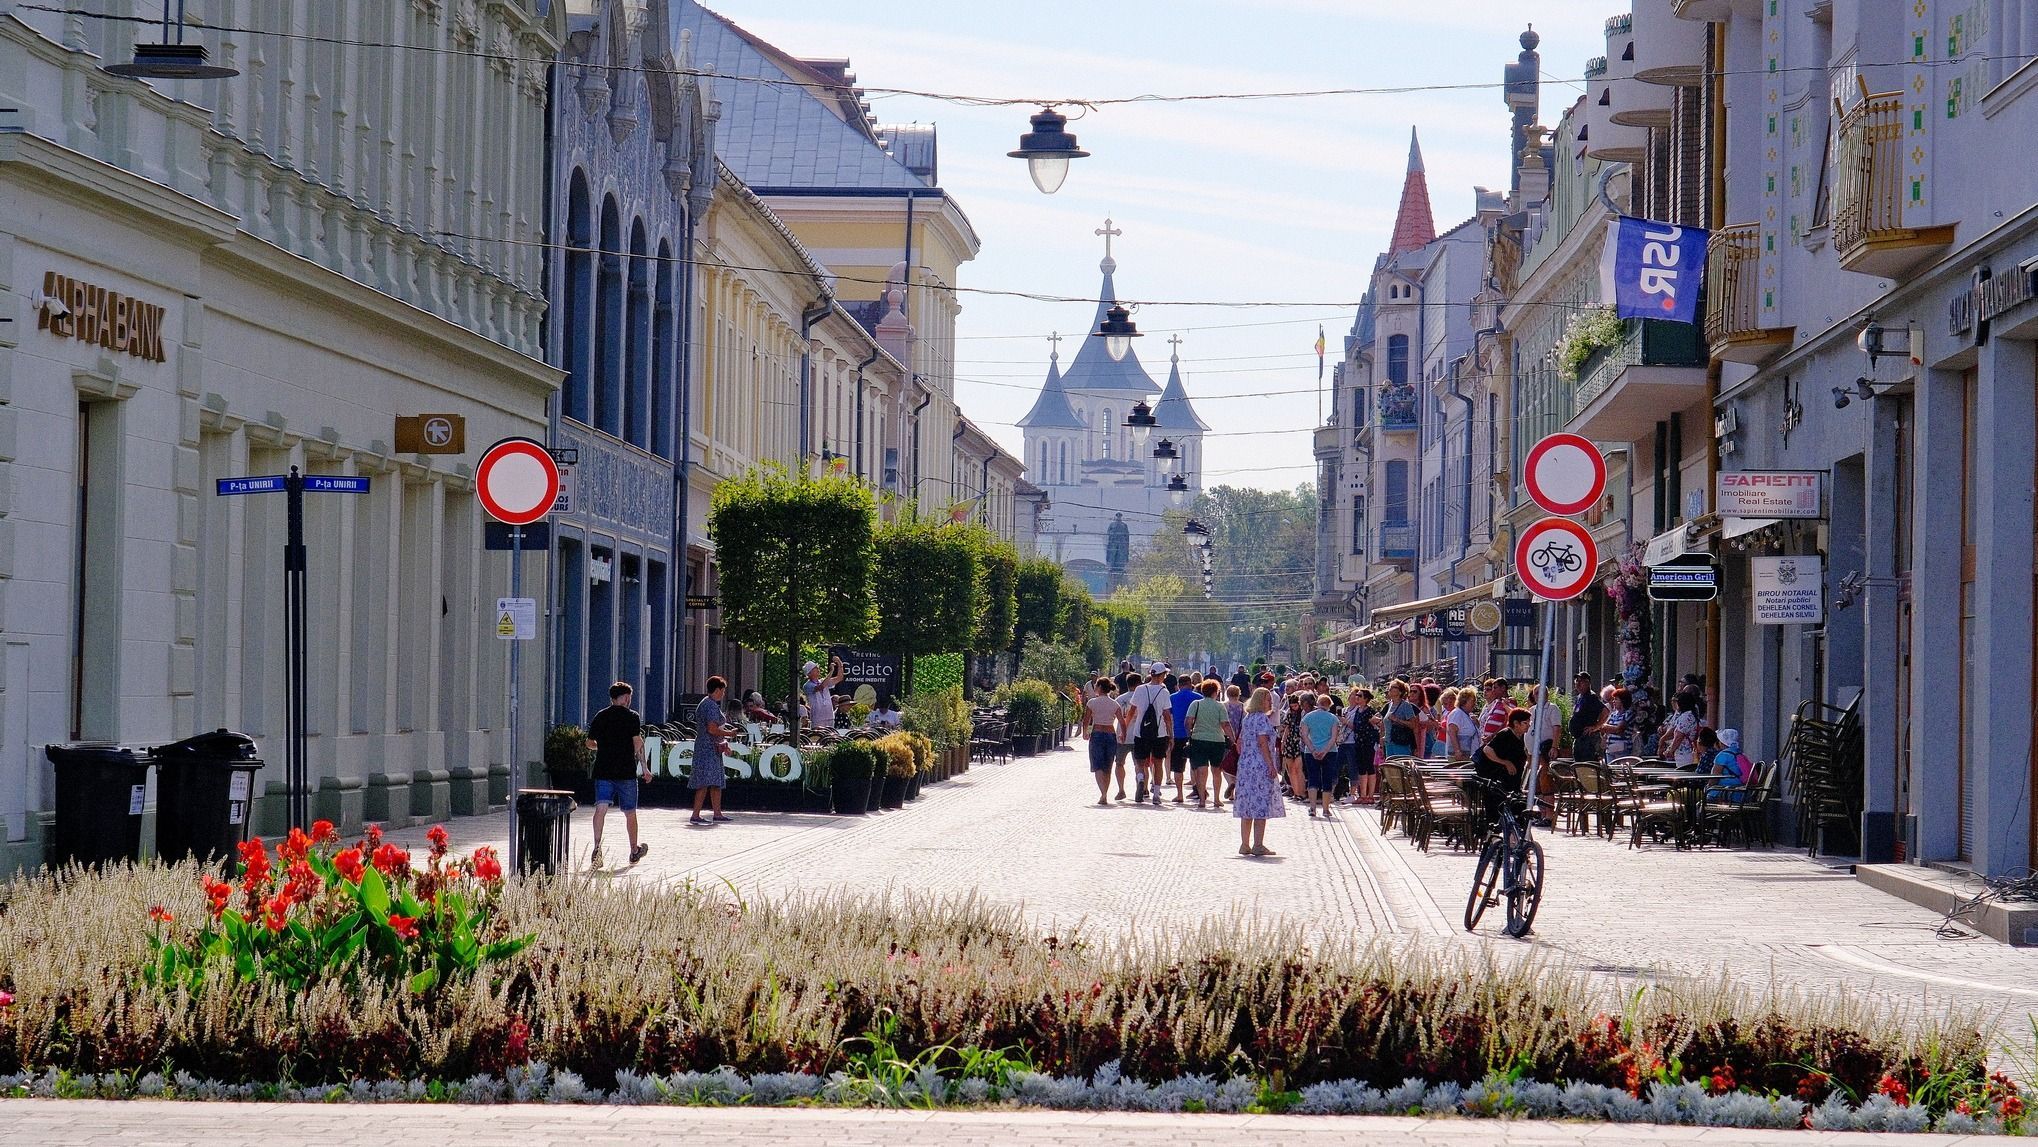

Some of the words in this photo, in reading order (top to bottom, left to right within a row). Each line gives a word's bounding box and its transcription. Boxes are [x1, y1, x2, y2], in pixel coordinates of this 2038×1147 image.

[249, 480, 274, 489] UNIRII
[333, 480, 357, 489] UNIRII
[1722, 475, 1815, 487] SAPIENT
[843, 661, 893, 676] Gelato
